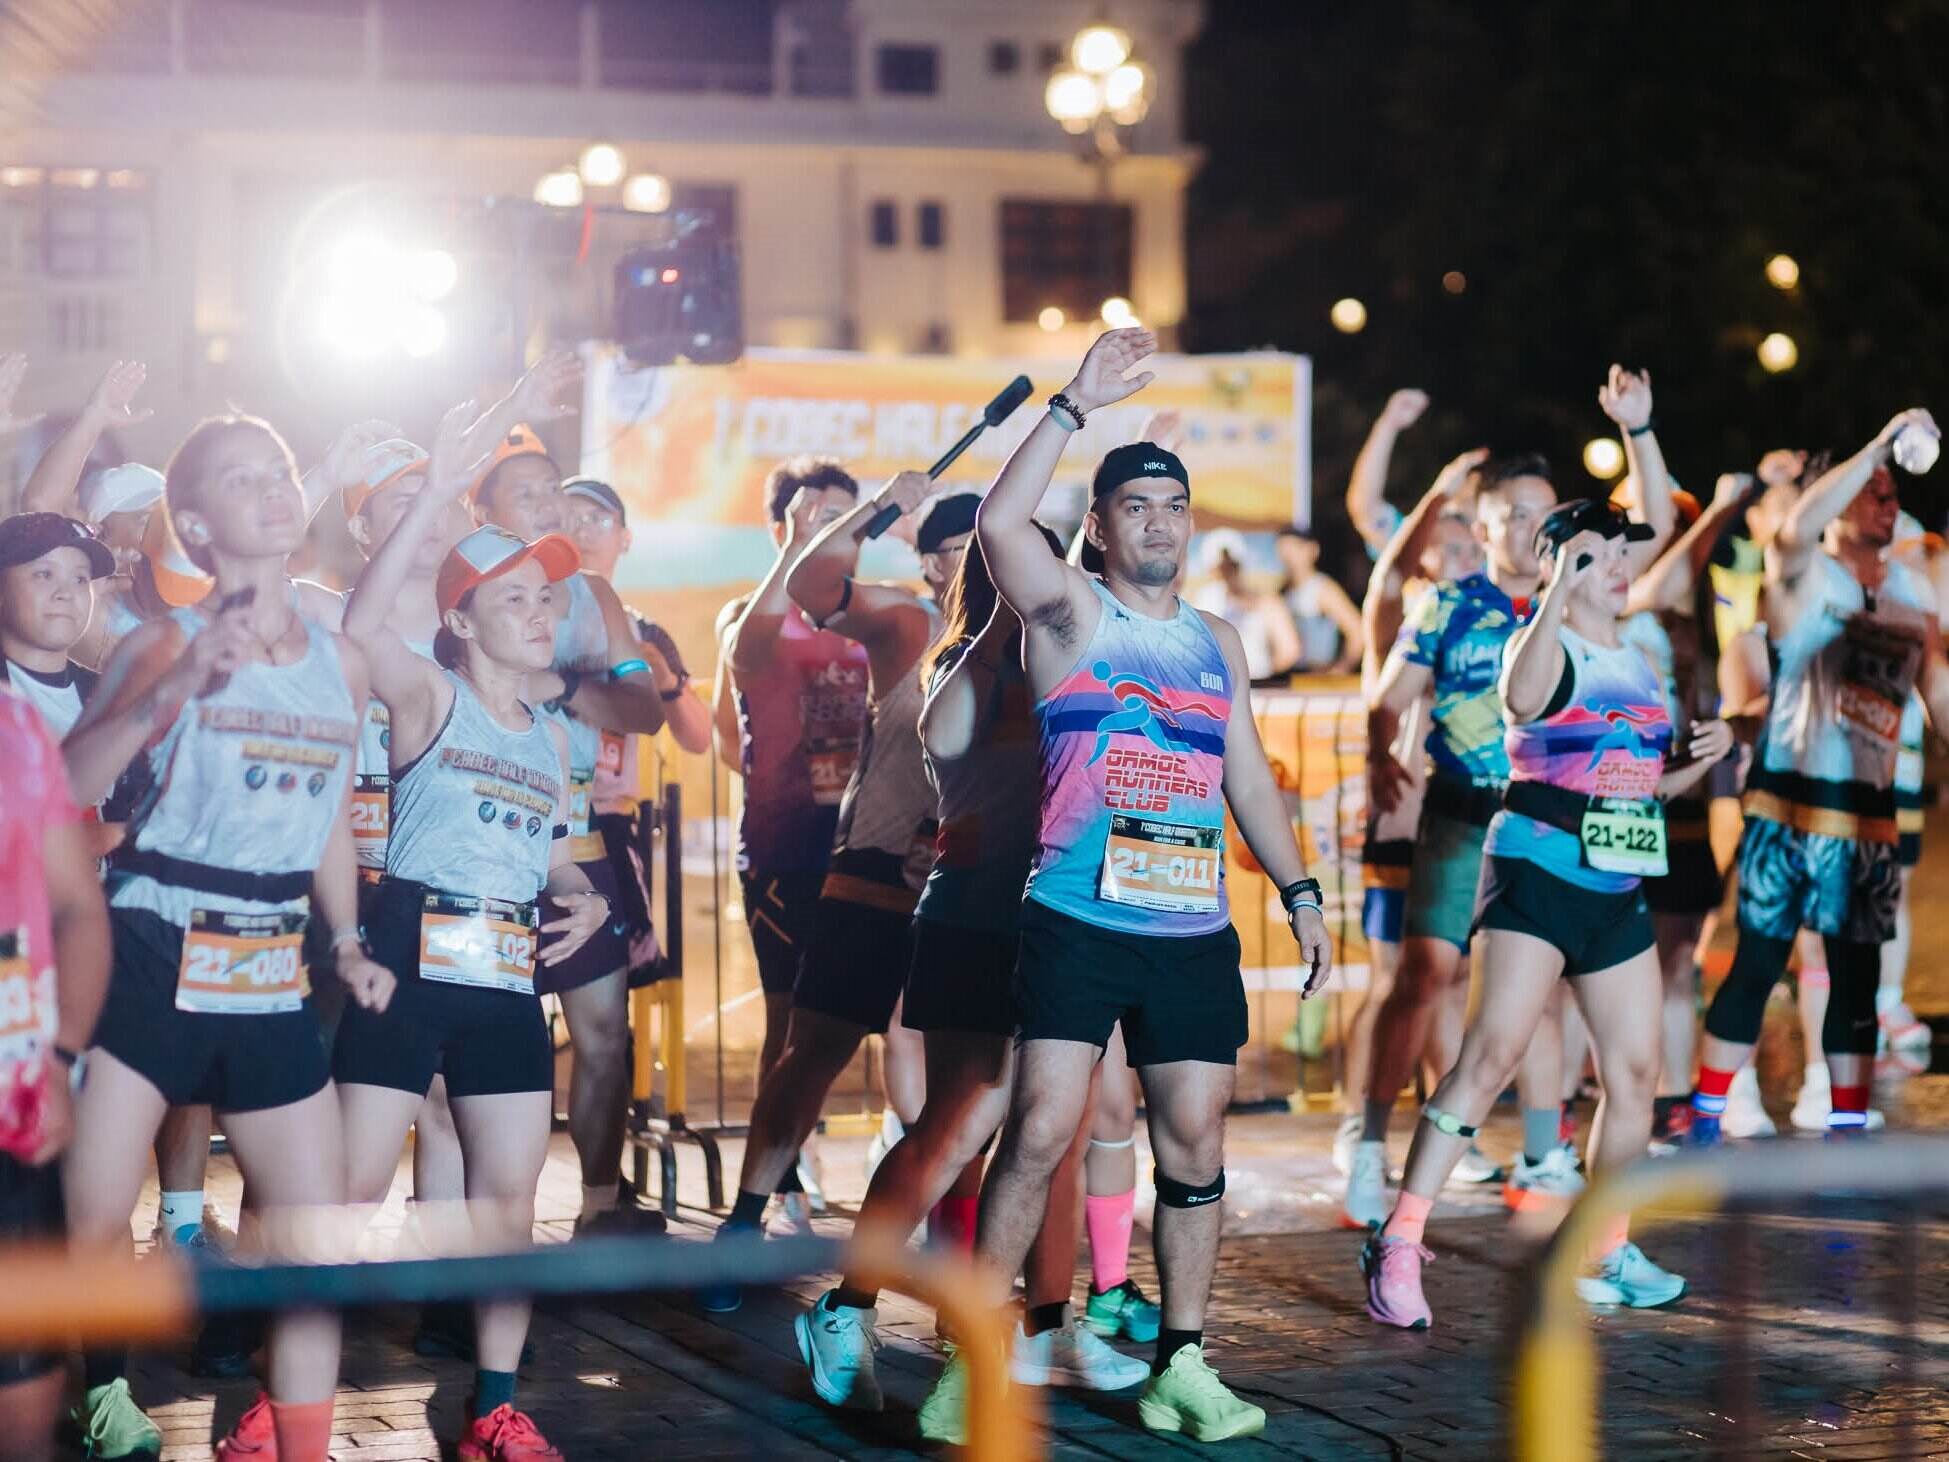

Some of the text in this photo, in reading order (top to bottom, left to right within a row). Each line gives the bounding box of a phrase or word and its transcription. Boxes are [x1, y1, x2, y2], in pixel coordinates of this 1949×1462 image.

[1143, 461, 1168, 471] NIKE
[1105, 748, 1188, 775] ORMOC
[1104, 768, 1209, 800] RUNNERS
[1103, 789, 1170, 813] CLUB
[1586, 823, 1659, 853] 21-122
[1112, 847, 1211, 889] 21-011
